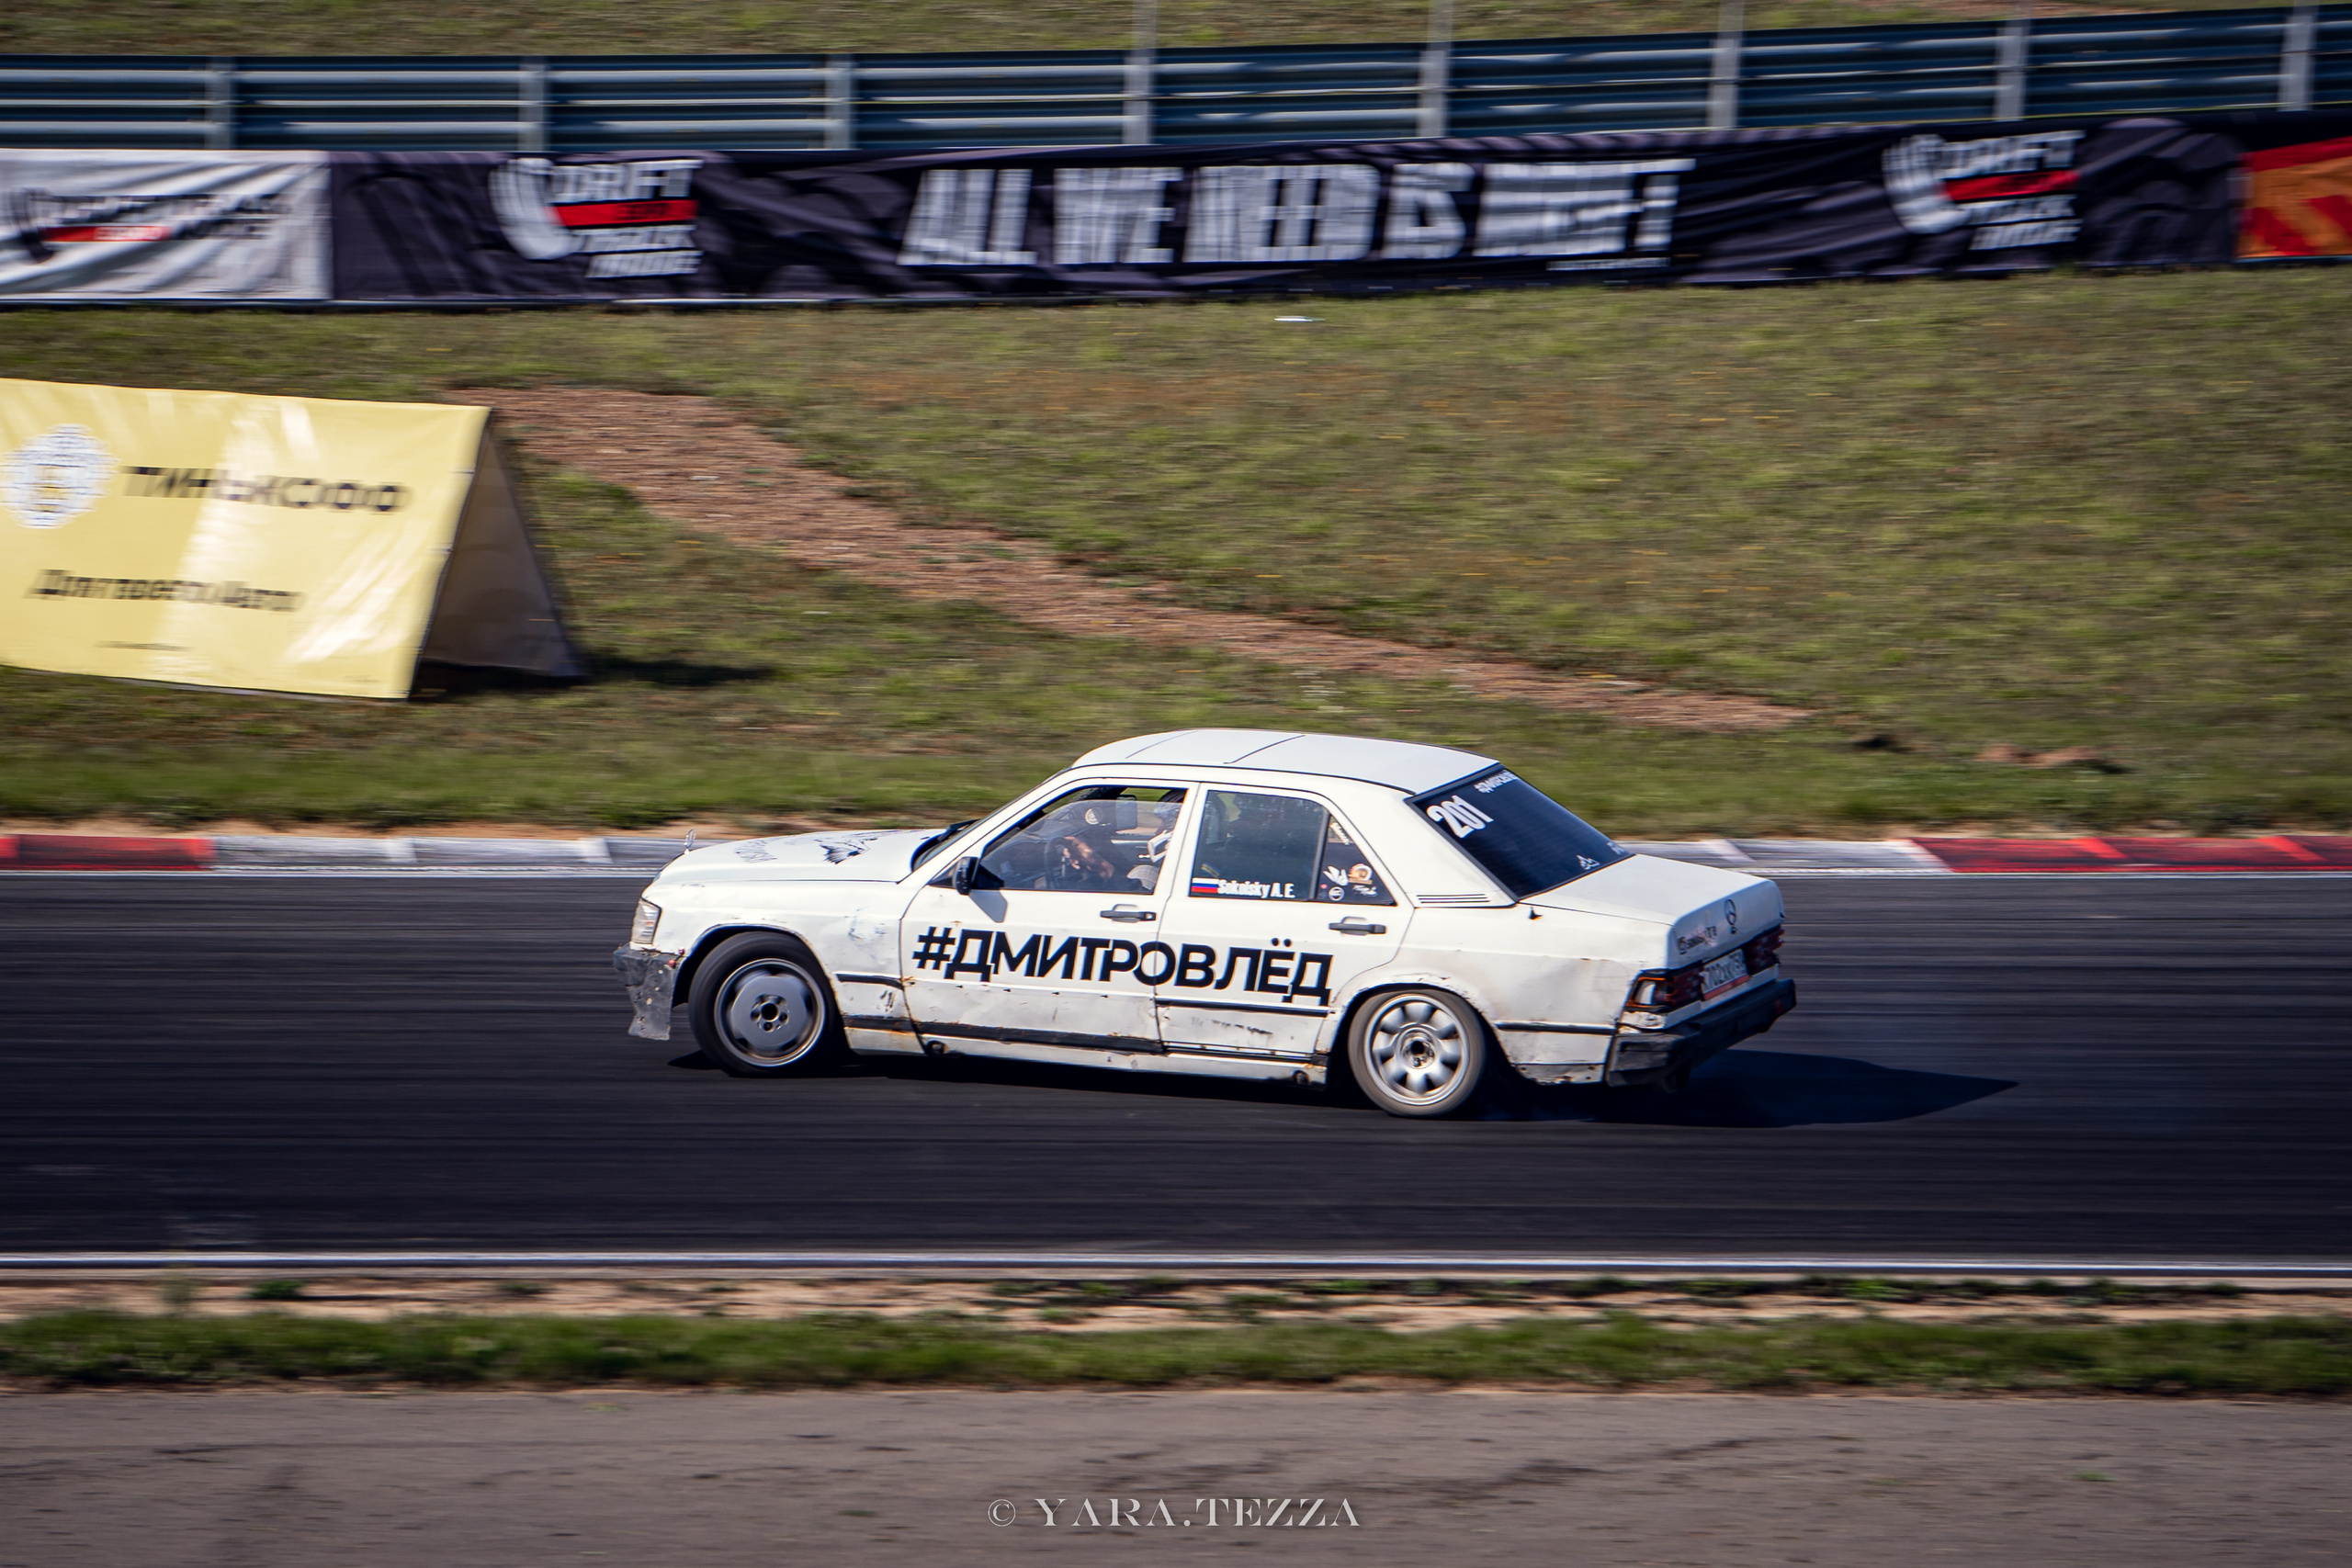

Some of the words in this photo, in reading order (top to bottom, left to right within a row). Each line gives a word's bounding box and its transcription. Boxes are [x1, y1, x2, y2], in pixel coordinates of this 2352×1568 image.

[898, 168, 1036, 265] ALL
[1053, 166, 1182, 264] WE
[1184, 164, 1381, 264] NEED
[1385, 162, 1477, 260] IS
[1426, 795, 1494, 839] 201
[912, 926, 1334, 1007] #ДМИТРОВЛЁД
